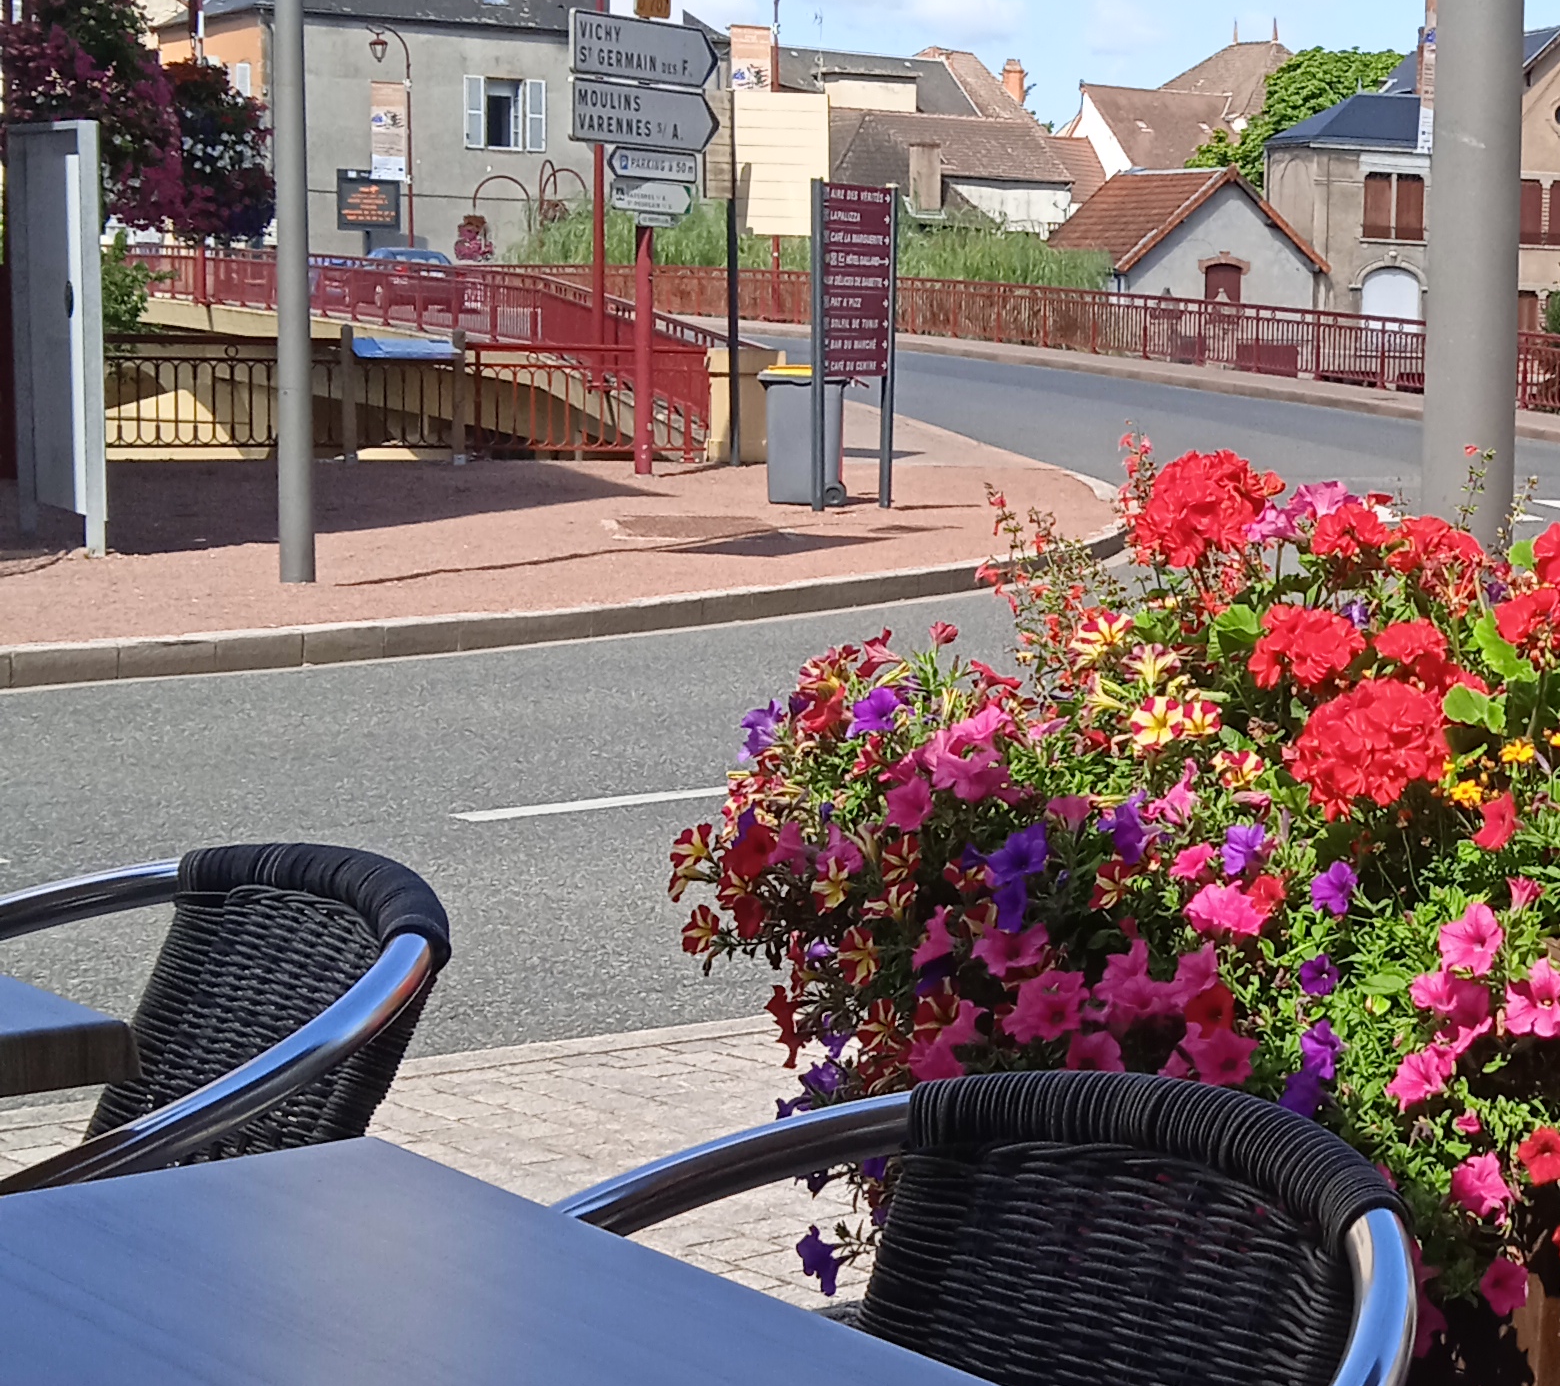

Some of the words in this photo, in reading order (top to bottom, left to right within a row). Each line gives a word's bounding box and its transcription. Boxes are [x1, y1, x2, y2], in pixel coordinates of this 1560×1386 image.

[579, 20, 621, 43] VICHY
[597, 47, 657, 73] GERMAIN
[577, 88, 641, 113] MOULINS
[577, 113, 652, 137] VARENNES
[631, 158, 665, 172] PARKING
[676, 161, 686, 173] 50
[830, 189, 844, 200] AIRE
[846, 190, 858, 201] DES
